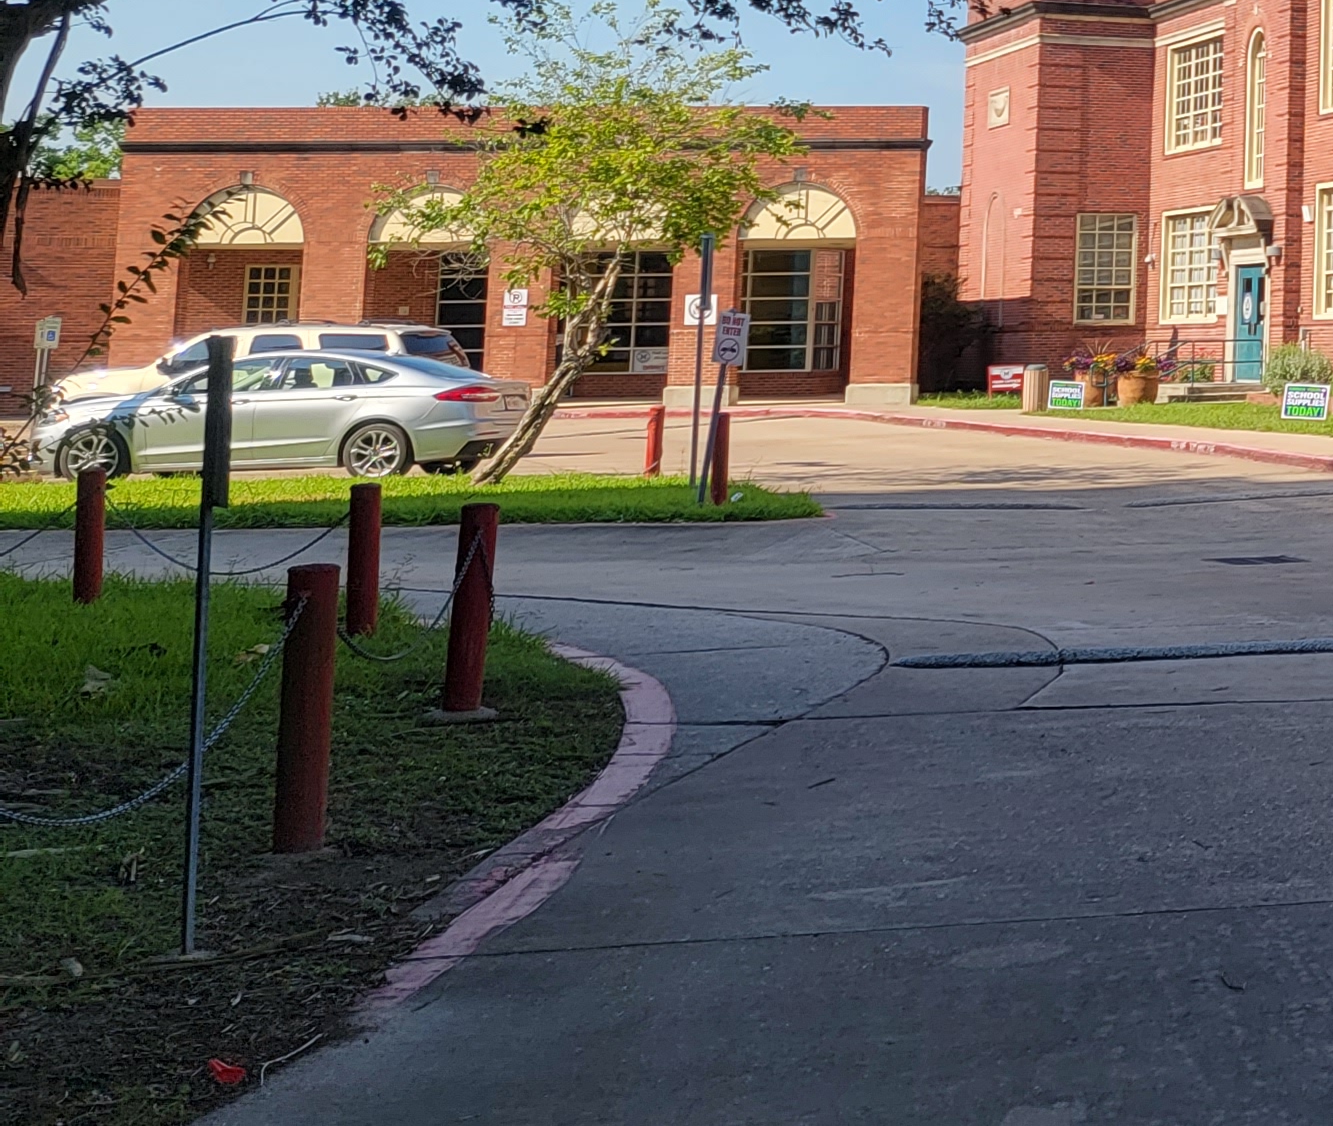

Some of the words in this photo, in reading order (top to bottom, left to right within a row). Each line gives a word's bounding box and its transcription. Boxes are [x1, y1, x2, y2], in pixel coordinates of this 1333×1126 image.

[732, 317, 745, 327] NOT
[1288, 391, 1325, 400] SCHOOL
[1286, 406, 1324, 417] TODAY!
